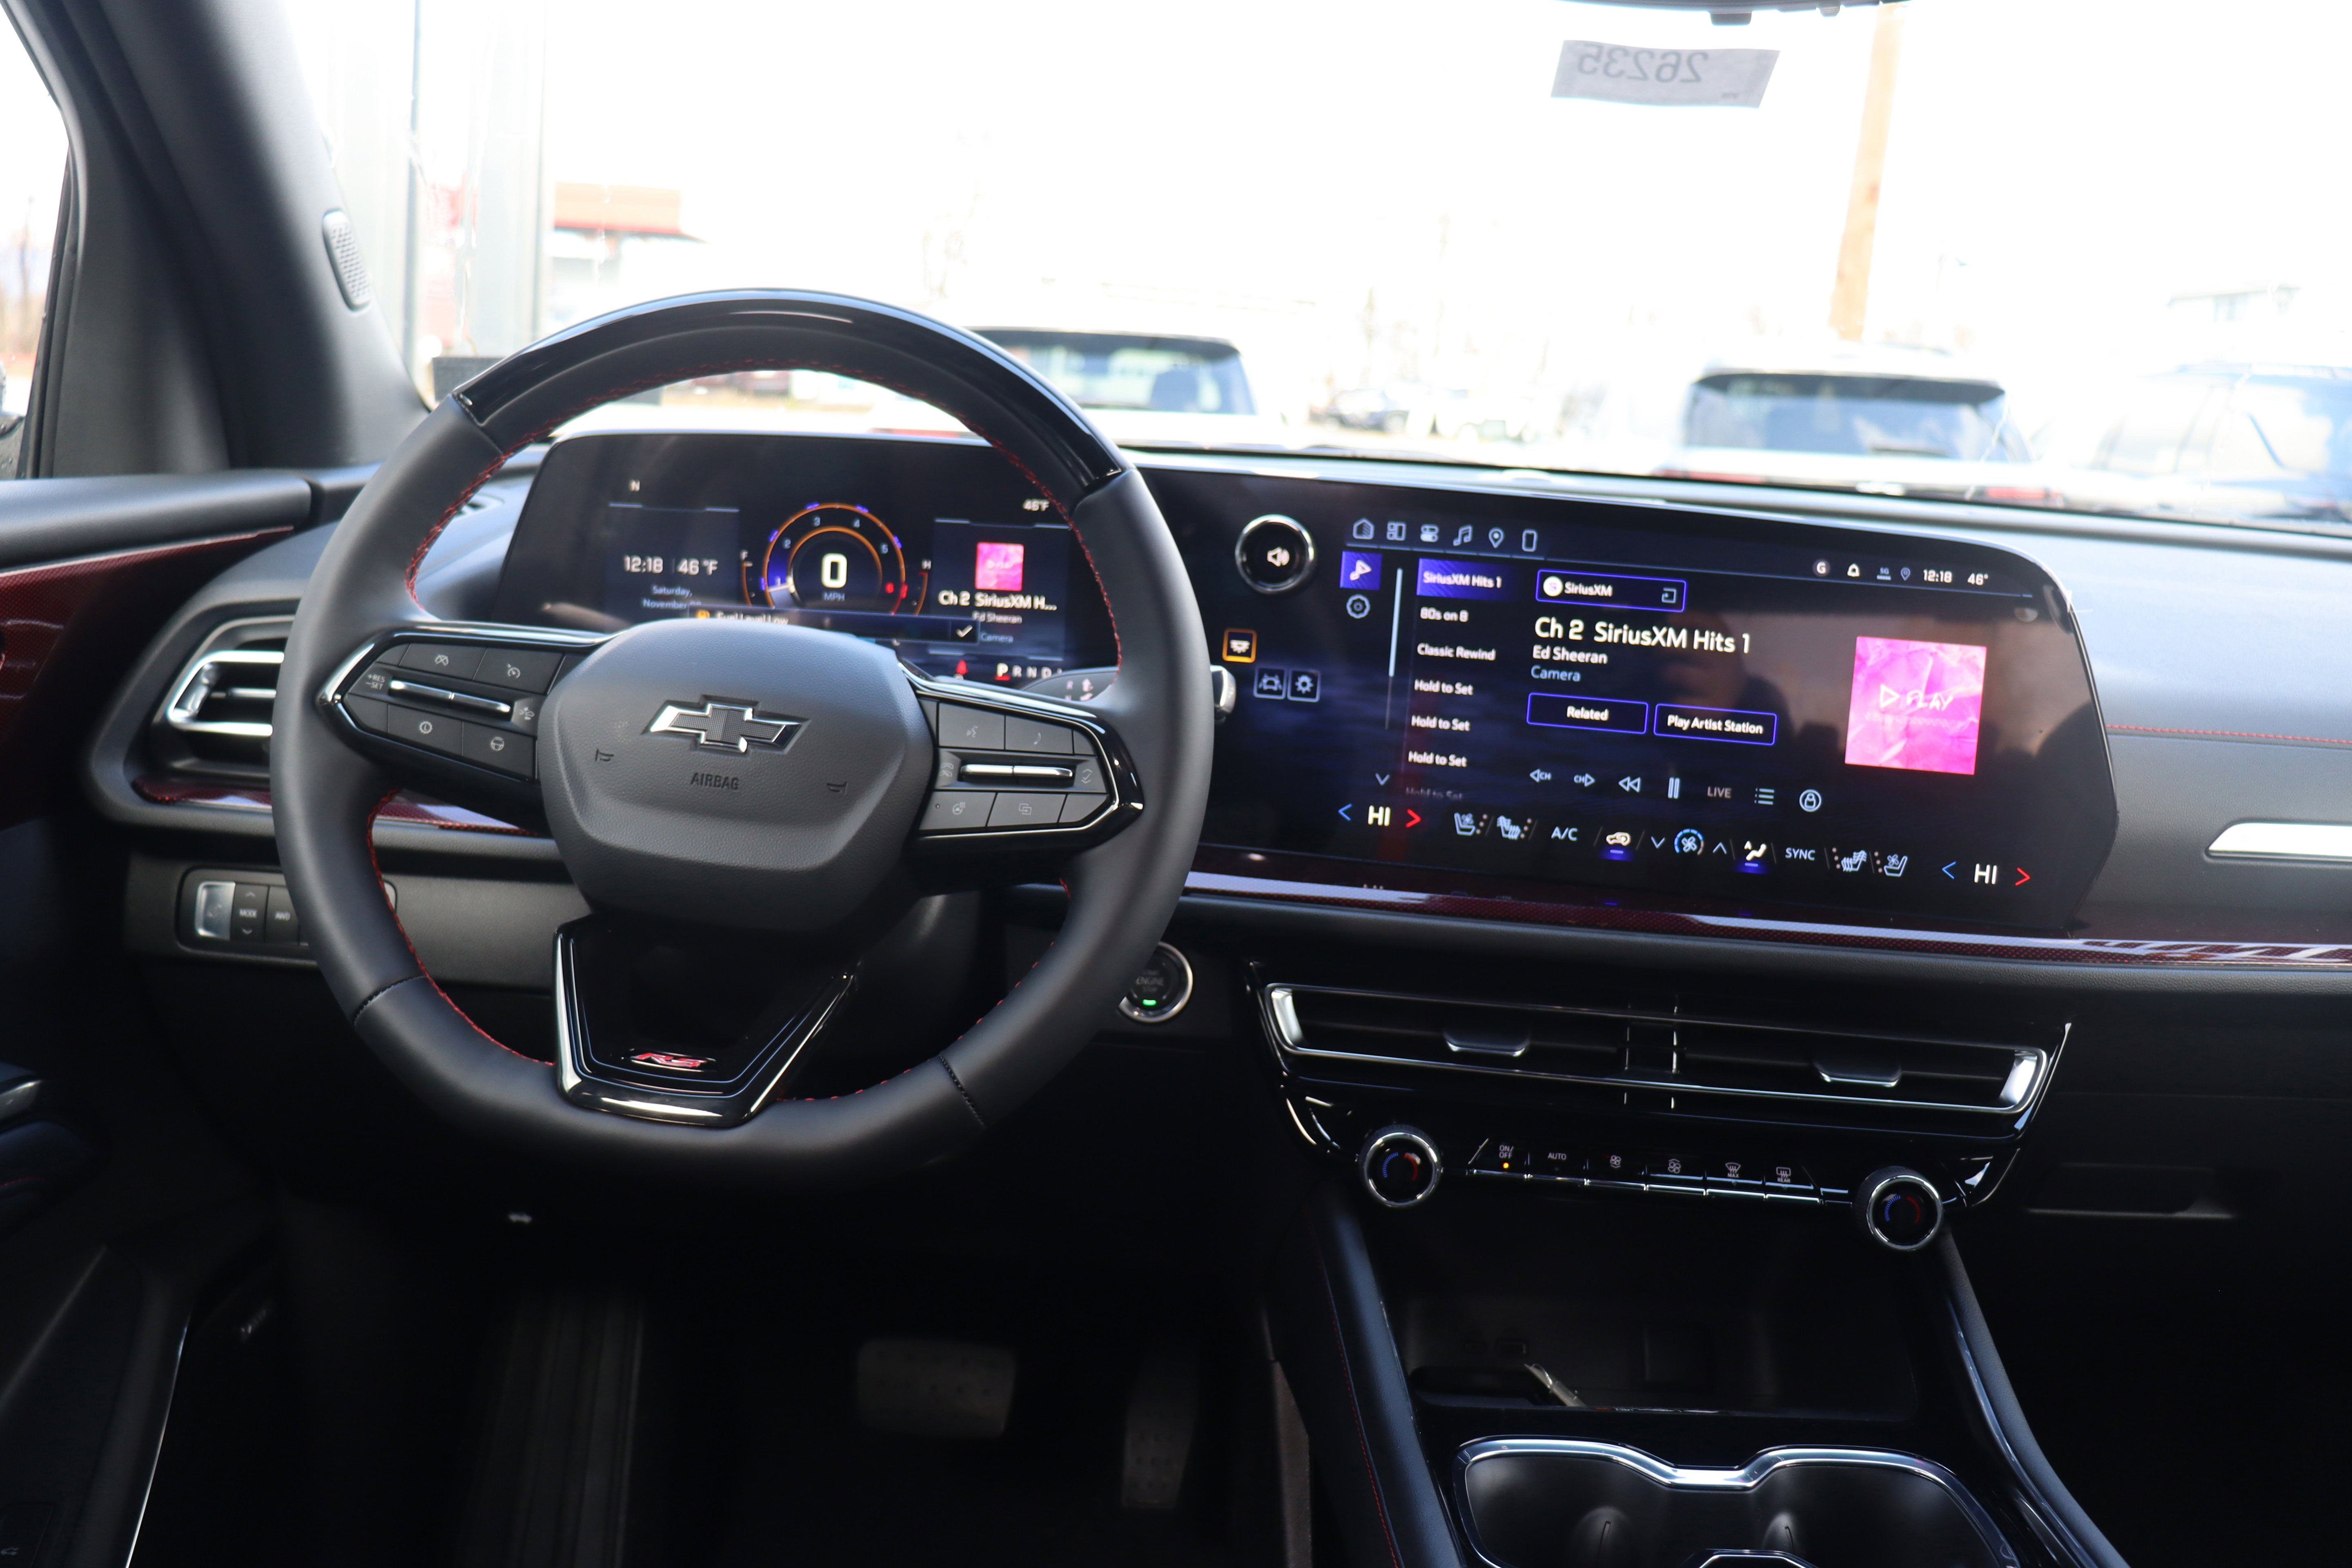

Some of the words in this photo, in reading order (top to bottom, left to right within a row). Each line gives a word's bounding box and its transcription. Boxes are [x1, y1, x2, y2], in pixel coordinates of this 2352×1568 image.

[629, 479, 640, 492] N
[813, 517, 821, 526] 3
[853, 518, 860, 528] 4
[784, 538, 791, 548] 2
[881, 544, 889, 555] 5
[624, 555, 663, 573] 12:18
[922, 560, 931, 570] H
[1423, 571, 1470, 586] SiriusXM
[1471, 574, 1494, 588] Hits
[1496, 576, 1502, 588] 1
[1923, 569, 1952, 583] 12:18
[1967, 572, 1989, 586] 46°
[824, 592, 845, 602] MPH
[1564, 582, 1613, 597] SiriusXM
[643, 598, 687, 610] November
[938, 590, 958, 605] Ch
[959, 591, 970, 606] 2
[974, 592, 1031, 609] SiriusXM
[987, 612, 1022, 624] Sheeran
[1420, 607, 1442, 620] 80s
[1443, 611, 1458, 621] on
[1459, 610, 1468, 622] 8
[980, 632, 1013, 643] Camera
[1535, 617, 1563, 638] Ch
[1568, 619, 1584, 640] 2
[1594, 621, 1687, 648] SiriusXM
[1693, 629, 1735, 653] Hits
[1742, 633, 1751, 653] 1
[1417, 643, 1454, 658] Classic
[1456, 646, 1496, 661] Rewind
[1532, 645, 1550, 659] Ed
[1552, 646, 1608, 664] Sheeran
[997, 663, 1008, 677] P
[1012, 665, 1022, 677] R
[1026, 666, 1037, 678] N
[1041, 666, 1052, 679] D
[1531, 665, 1581, 682] Camera
[1414, 679, 1441, 693] Hold
[1441, 682, 1454, 693] to
[1454, 682, 1474, 695] Set
[1907, 689, 1953, 711] PLAY
[1566, 706, 1609, 721] Related
[1411, 715, 1437, 728] Hold
[1438, 718, 1450, 729] to
[1452, 718, 1470, 731] Set
[1667, 715, 1690, 731] Play
[1691, 717, 1723, 731] Artist
[1724, 719, 1763, 734] Station
[1408, 751, 1434, 764] Hold
[1435, 754, 1448, 765] to
[1448, 754, 1467, 767] Set
[690, 772, 739, 791] AIRBAG
[1539, 772, 1551, 780] CH
[1574, 775, 1584, 784] CH
[1707, 786, 1731, 798] LIVE
[1368, 805, 1391, 826] HI
[1551, 826, 1578, 841] A/C
[1785, 847, 1815, 861] SYNC
[1974, 863, 1998, 885] HI
[631, 1053, 708, 1068] RS
